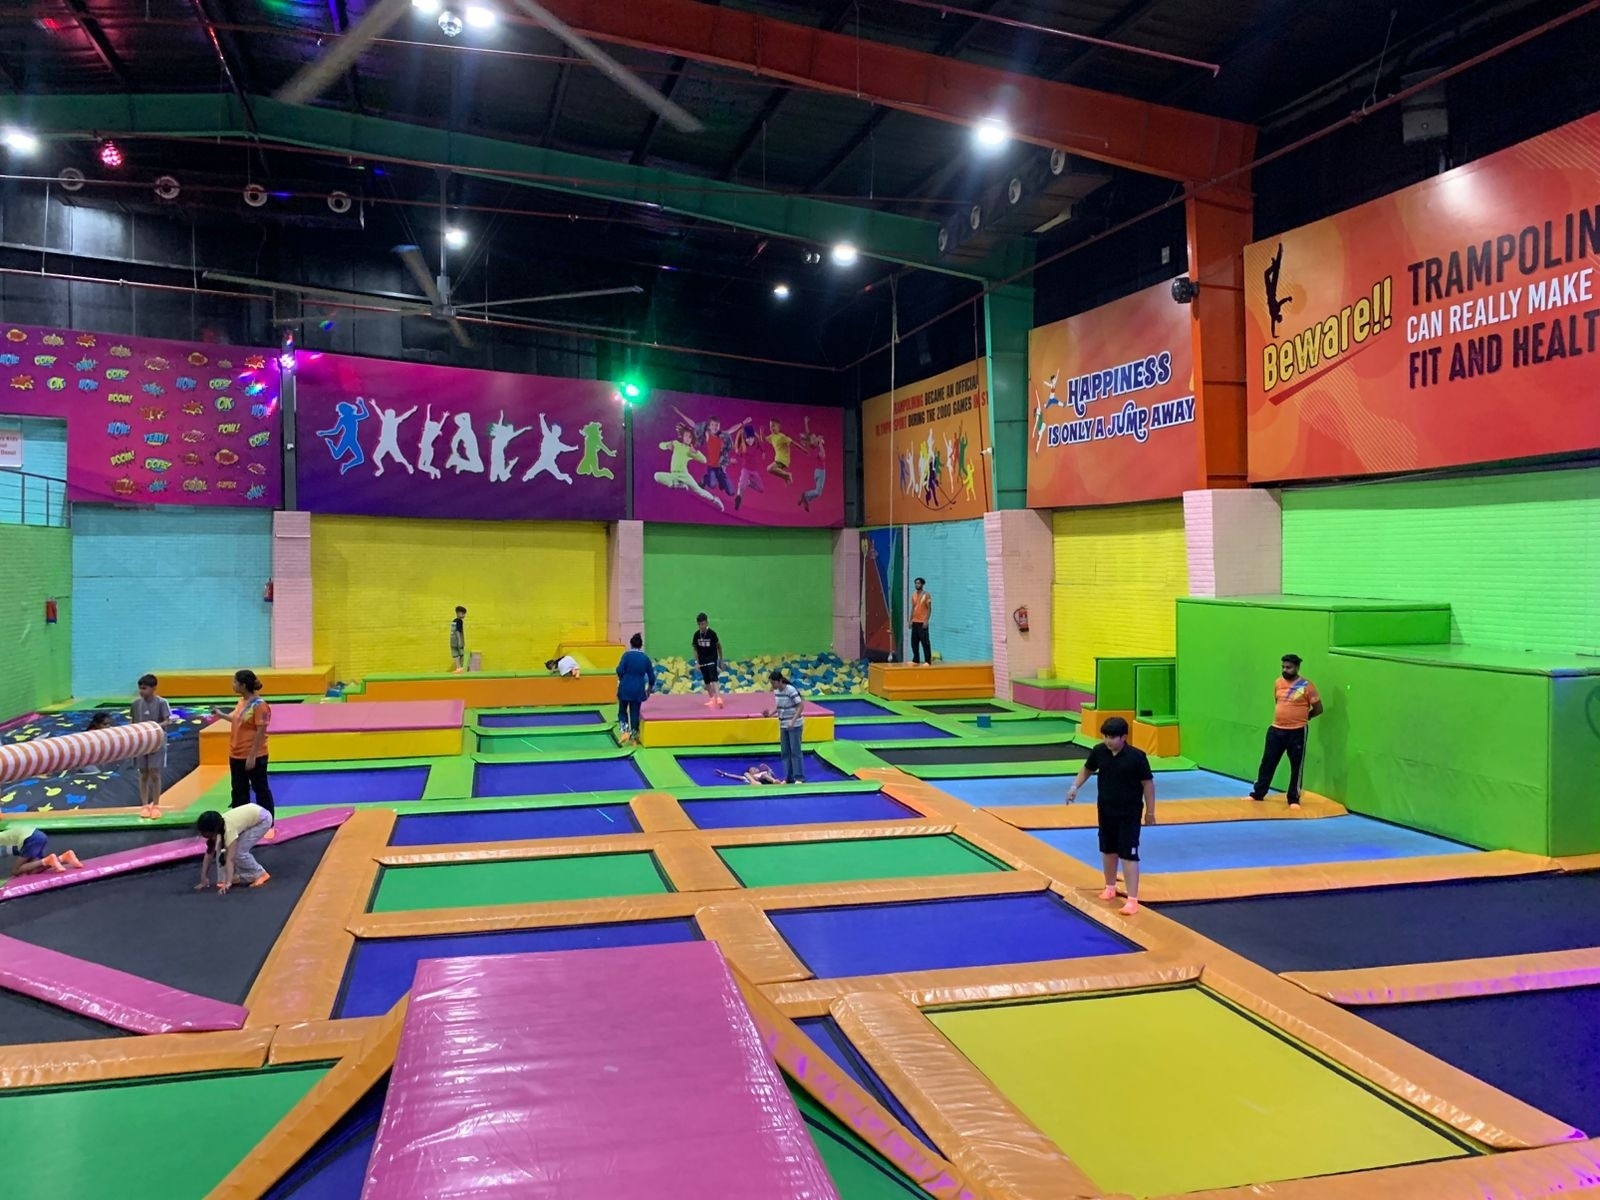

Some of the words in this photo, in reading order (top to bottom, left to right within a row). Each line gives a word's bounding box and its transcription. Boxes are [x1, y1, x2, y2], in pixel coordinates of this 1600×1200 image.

[1408, 204, 1600, 306] TRAMPOLIN
[1263, 275, 1392, 393] Beware!!
[1407, 309, 1443, 344] CAN
[1450, 287, 1522, 334] REALLY
[1528, 268, 1593, 315] MAKE
[1409, 346, 1442, 389] FIT
[1449, 333, 1503, 382] AND
[1513, 309, 1600, 368] HEALT
[49, 377, 65, 390] OK
[217, 396, 233, 411] OK
[925, 386, 945, 406] BECAME
[946, 383, 954, 398] AN
[926, 407, 936, 423] THE
[937, 404, 952, 420] 2000
[953, 396, 972, 415] GAMES
[1067, 351, 1171, 417] HAPPINESS
[1048, 424, 1060, 446] IS
[1061, 418, 1094, 444] ONLY
[1095, 417, 1106, 440] A
[1107, 401, 1149, 442] JUMP
[1150, 396, 1195, 429] AWAY
